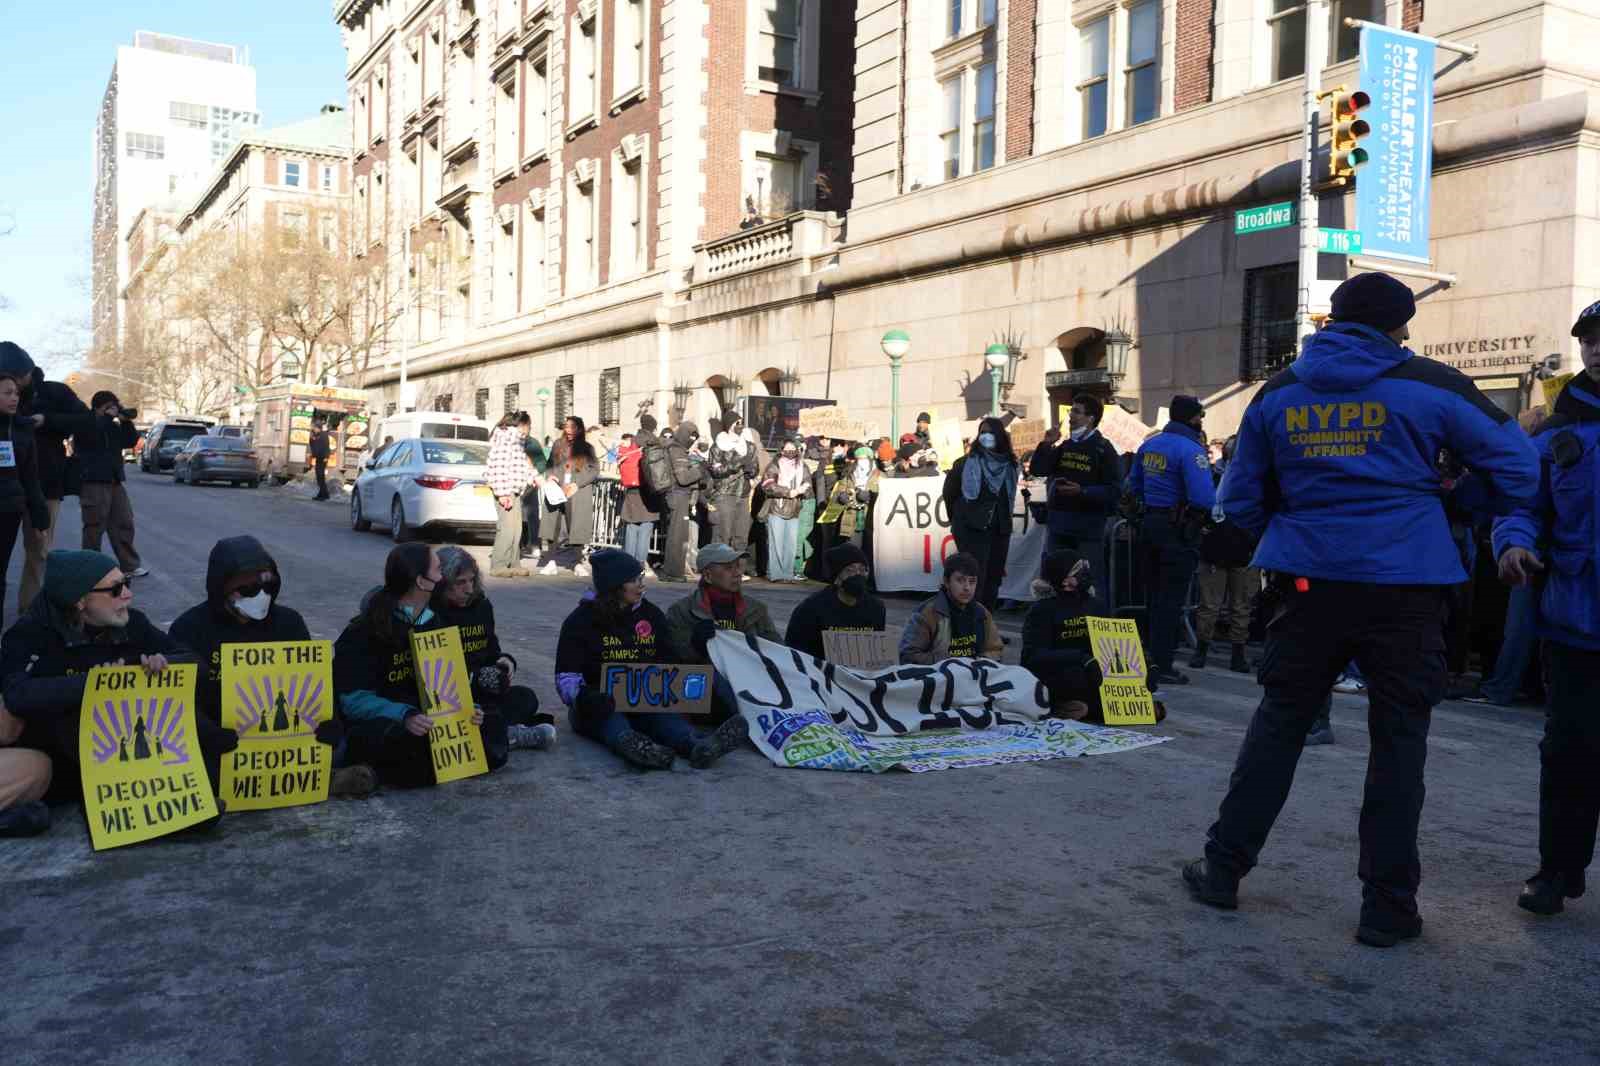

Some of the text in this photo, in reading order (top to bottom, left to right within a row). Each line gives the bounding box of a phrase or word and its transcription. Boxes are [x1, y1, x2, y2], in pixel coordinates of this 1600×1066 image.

[1385, 43, 1403, 241] COLUMBIA UNIVERSITY
[1396, 46, 1418, 243] MILLER THEATRE
[1331, 233, 1350, 251] 116
[1423, 335, 1536, 356] UNIVERSITY
[1481, 354, 1535, 368] THEATRE
[1286, 402, 1387, 432] NYPD
[1289, 431, 1384, 445] COMMUNITY
[1303, 444, 1367, 458] AFFAIRS
[1092, 620, 1110, 632] FOR
[1113, 621, 1135, 633] THE
[414, 632, 449, 652] THE
[232, 648, 275, 666] FOR
[282, 645, 323, 664] THE
[95, 671, 137, 691] FOR
[143, 669, 185, 689] THE
[606, 665, 680, 707] FUCK
[1104, 685, 1148, 698] PEOPLE
[1107, 700, 1152, 716] WE LOVE
[233, 745, 322, 771] PEOPLE
[434, 740, 476, 771] LOVE
[96, 772, 198, 804] PEOPLE
[233, 769, 322, 798] WE LOVE
[100, 791, 205, 835] WE LOVE
